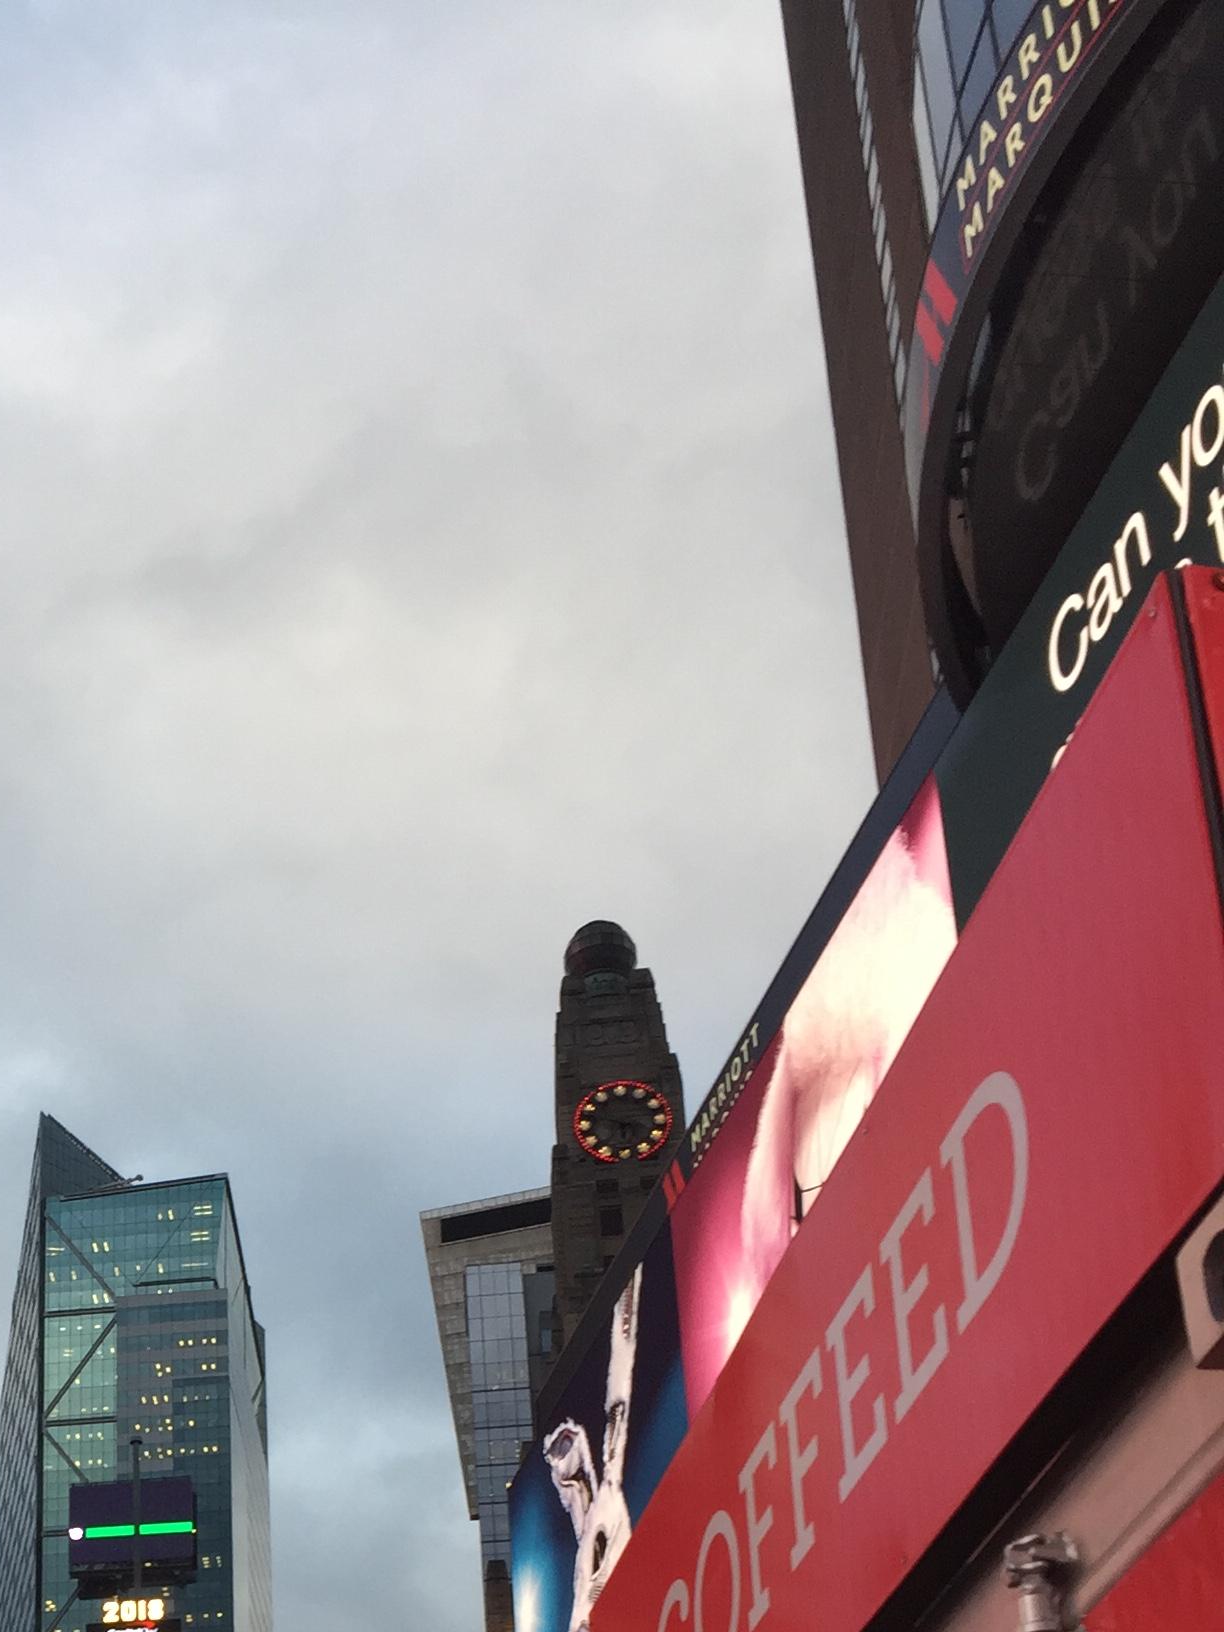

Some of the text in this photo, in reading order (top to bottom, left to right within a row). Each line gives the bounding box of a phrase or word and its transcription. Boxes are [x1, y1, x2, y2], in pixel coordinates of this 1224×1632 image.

[956, 0, 1076, 212] MARRI
[963, 0, 1117, 258] MARQUI
[1048, 511, 1152, 692] Can
[690, 1022, 759, 1152] MARRIOTT
[102, 1599, 165, 1623] 2018
